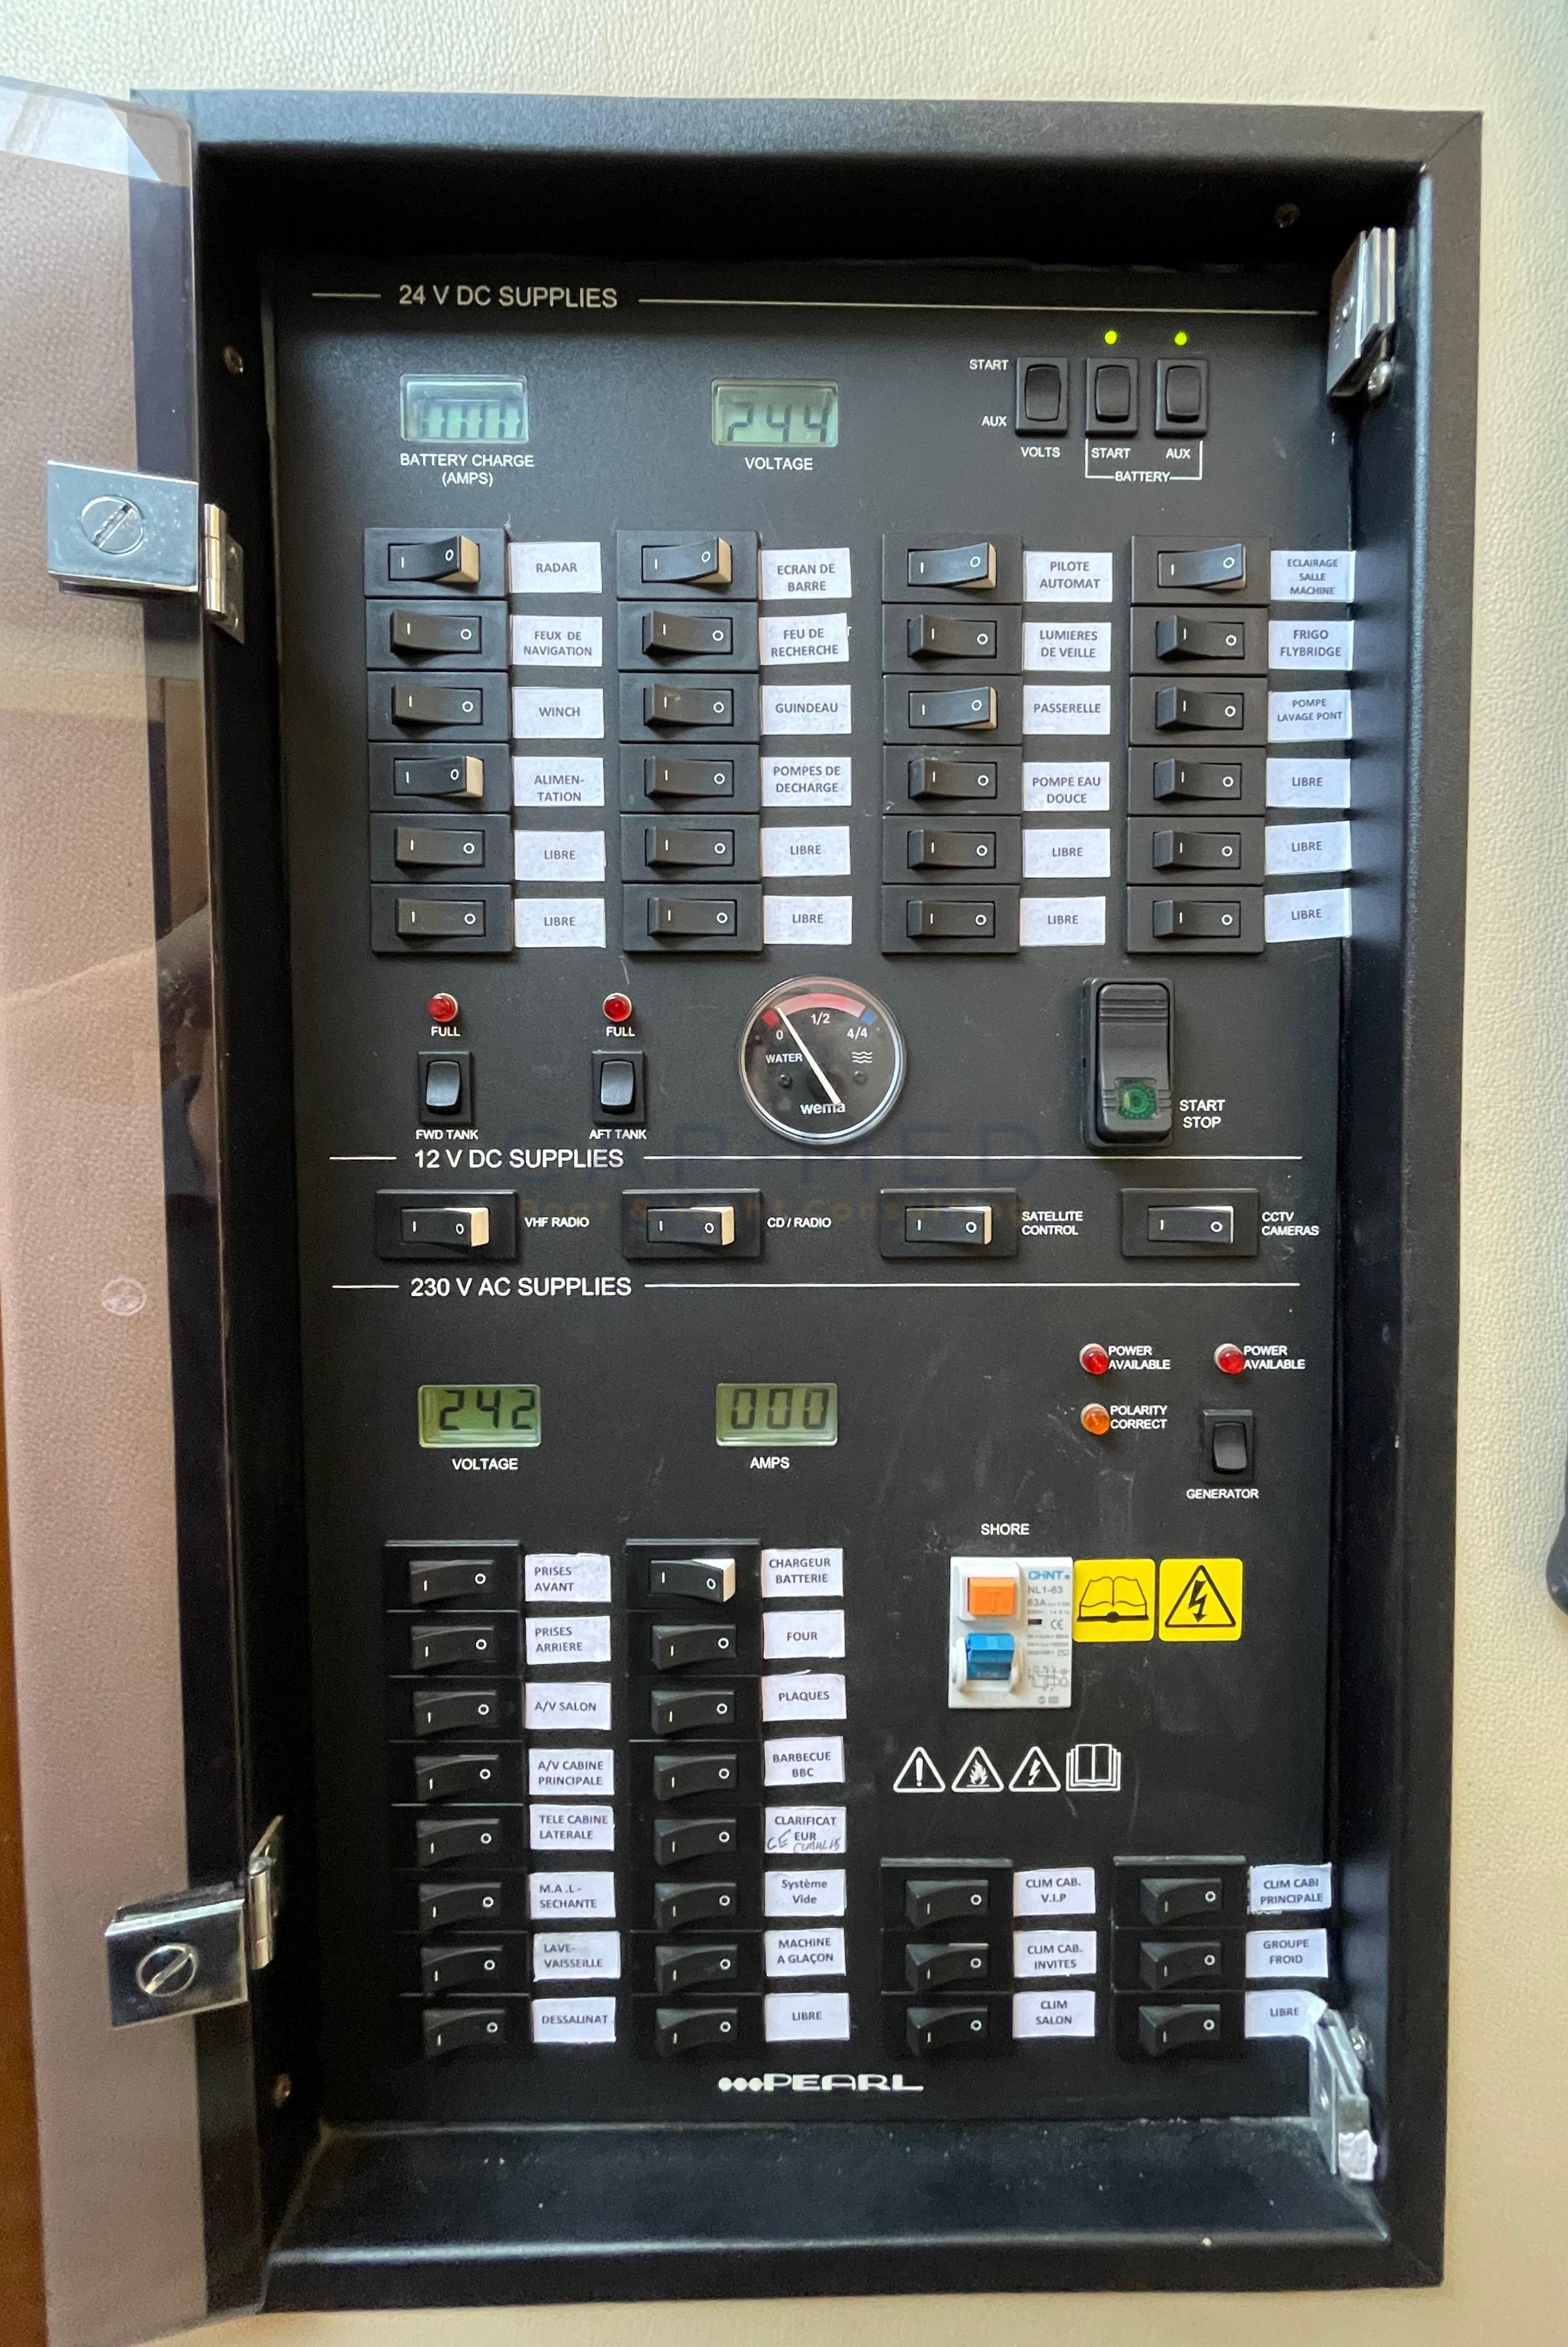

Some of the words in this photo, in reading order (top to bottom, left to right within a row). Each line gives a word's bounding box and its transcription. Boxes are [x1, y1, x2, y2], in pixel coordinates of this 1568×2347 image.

[399, 284, 426, 306] 24
[432, 285, 450, 306] V
[457, 285, 491, 306] DC
[498, 286, 617, 308] SUPPLIES
[969, 359, 1009, 370] START
[981, 416, 1007, 427] AUX
[1020, 446, 1061, 458] VOLTS
[1091, 447, 1131, 459] START
[1165, 448, 1191, 459] AUX
[400, 453, 467, 467] BATTERY
[471, 453, 534, 468] CHARGE
[744, 457, 814, 471] VOLTAGE
[441, 471, 494, 488] (AMPS)
[1115, 471, 1171, 482] BATTERY
[536, 562, 578, 573] RADAR
[1050, 561, 1089, 572] PILOTE
[1287, 558, 1338, 568] ECLAIRAGE
[777, 564, 816, 575] ECRAN
[819, 563, 835, 574] DE
[1299, 572, 1326, 581] SALLE
[787, 581, 826, 592] BARRE
[1039, 578, 1101, 589] AUTOMAT
[1290, 586, 1335, 595] MACHINE
[534, 630, 561, 641] FEUX
[567, 631, 581, 641] DE
[783, 628, 805, 640] FEU
[808, 628, 825, 639] DE
[1039, 630, 1098, 641] LUMIERES
[1293, 629, 1329, 640] FRIGO
[524, 646, 592, 656] NAVIGATION
[770, 644, 839, 658] RECHERCHE
[1041, 646, 1056, 657] DE
[1059, 647, 1096, 658] VEILLE
[1280, 646, 1342, 657] FLYBRIDGE
[775, 702, 838, 713] GUINDEAU
[1034, 703, 1101, 713] PASSERELLE
[1292, 698, 1327, 708] POMPE
[538, 706, 580, 717] WINCH
[1277, 712, 1314, 722] LAVAGE
[1317, 711, 1343, 721] PONT
[773, 765, 823, 776] POMPES
[825, 765, 841, 776] DE
[534, 774, 585, 785] ALIMEN-
[1032, 776, 1075, 787] POMPE
[1077, 776, 1101, 787] EAU
[1291, 776, 1323, 787] LIBRE
[776, 782, 839, 793] DECHARGE
[537, 792, 581, 802] TATION
[1046, 793, 1087, 804] DOUCE
[790, 845, 822, 855] LIBRE
[1052, 847, 1083, 857] LIBRE
[1291, 841, 1322, 852] LIBRE
[544, 850, 576, 860] LIBRE
[792, 913, 824, 924] LIBRE
[1291, 908, 1322, 920] LIBRE
[543, 917, 576, 927] LIBRE
[1048, 915, 1079, 925] LIBRE
[810, 1012, 830, 1026] 1/2
[430, 1026, 461, 1037] FULL
[606, 1026, 635, 1037] FULL
[776, 1029, 784, 1040] 0
[846, 1027, 868, 1040] 4/4
[765, 1053, 803, 1064] WATER
[1179, 1099, 1226, 1112] START
[1183, 1116, 1221, 1129] STOP
[415, 1129, 444, 1140] FWD
[446, 1129, 479, 1140] TANK
[588, 1129, 612, 1140] AFT
[614, 1129, 647, 1140] TANK
[415, 1149, 440, 1168] 12
[445, 1149, 463, 1168] V
[469, 1149, 502, 1169] DC
[509, 1148, 624, 1169] SUPPLIES
[1021, 1210, 1084, 1221] SATELLITE
[1261, 1211, 1295, 1222] CCTV
[524, 1216, 549, 1228] VHF
[551, 1216, 590, 1228] RADIO
[767, 1217, 785, 1228] CD
[794, 1217, 832, 1228] RADIO
[1021, 1225, 1079, 1236] CONTROL
[1261, 1225, 1320, 1236] CAMERAS
[410, 1277, 450, 1297] 230
[455, 1277, 473, 1297] V
[478, 1277, 511, 1297] AC
[517, 1277, 632, 1297] SUPPLIES
[1108, 1345, 1153, 1356] POWER
[1243, 1345, 1288, 1356] POWER
[1108, 1359, 1171, 1370] AVAILABLE
[1243, 1358, 1306, 1370] AVAILABLE
[439, 1389, 536, 1430] 242
[731, 1388, 828, 1430] 000
[1110, 1405, 1168, 1416] POLARITY
[1110, 1418, 1168, 1430] CORRECT
[451, 1457, 518, 1470] VOLTAGE
[749, 1456, 790, 1469] AMPS
[1186, 1488, 1259, 1499] GENERATOR
[980, 1522, 1030, 1536] SHORE
[769, 1557, 831, 1569] CHARGEUR
[534, 1566, 572, 1576] PRISES
[776, 1573, 828, 1584] BATTERIE
[534, 1582, 574, 1592] AVANT
[534, 1626, 572, 1637] PRISES
[787, 1631, 817, 1641] FOUR
[536, 1641, 583, 1652] ARRIERE
[778, 1690, 830, 1702] PLAQUES
[534, 1700, 556, 1713] A/V
[559, 1702, 597, 1712] SALON
[772, 1751, 831, 1763] BARBECUE
[538, 1760, 560, 1772] A/V
[562, 1760, 603, 1771] CABINE
[792, 1767, 814, 1778] BBC
[538, 1776, 603, 1785] PRINCIPALE
[538, 1814, 564, 1824] TELE
[567, 1814, 608, 1825] CABINE
[774, 1816, 837, 1826] CLARIFICAT
[540, 1830, 593, 1840] LATERALE
[794, 1831, 816, 1841] EUR
[781, 1878, 828, 1891] Système
[1025, 1878, 1053, 1888] CLIM
[1055, 1877, 1081, 1887] CAB.
[1263, 1879, 1291, 1890] CLIM
[540, 1899, 596, 1908] SECHANTE
[792, 1894, 817, 1904] Vide
[1260, 1893, 1323, 1905] PRINCIPALE
[543, 1943, 575, 1953] LAVE-
[778, 1937, 831, 1949] MACHINE
[1263, 1939, 1309, 1950] GROUPE
[1027, 1945, 1054, 1955] CLIM
[1057, 1944, 1083, 1953] CAB.
[543, 1959, 603, 1968] VAISSEILLE
[777, 1955, 785, 1964] A
[788, 1953, 834, 1965] GLAÇON
[1034, 1959, 1077, 1970] INVITES
[1269, 1954, 1303, 1965] FROID
[1040, 2000, 1068, 2010] CLIM
[792, 2011, 822, 2021] LIBRE
[1270, 2007, 1299, 2018] LIBRE
[1035, 2015, 1072, 2025] SALON
[760, 2073, 924, 2092] PEARL
